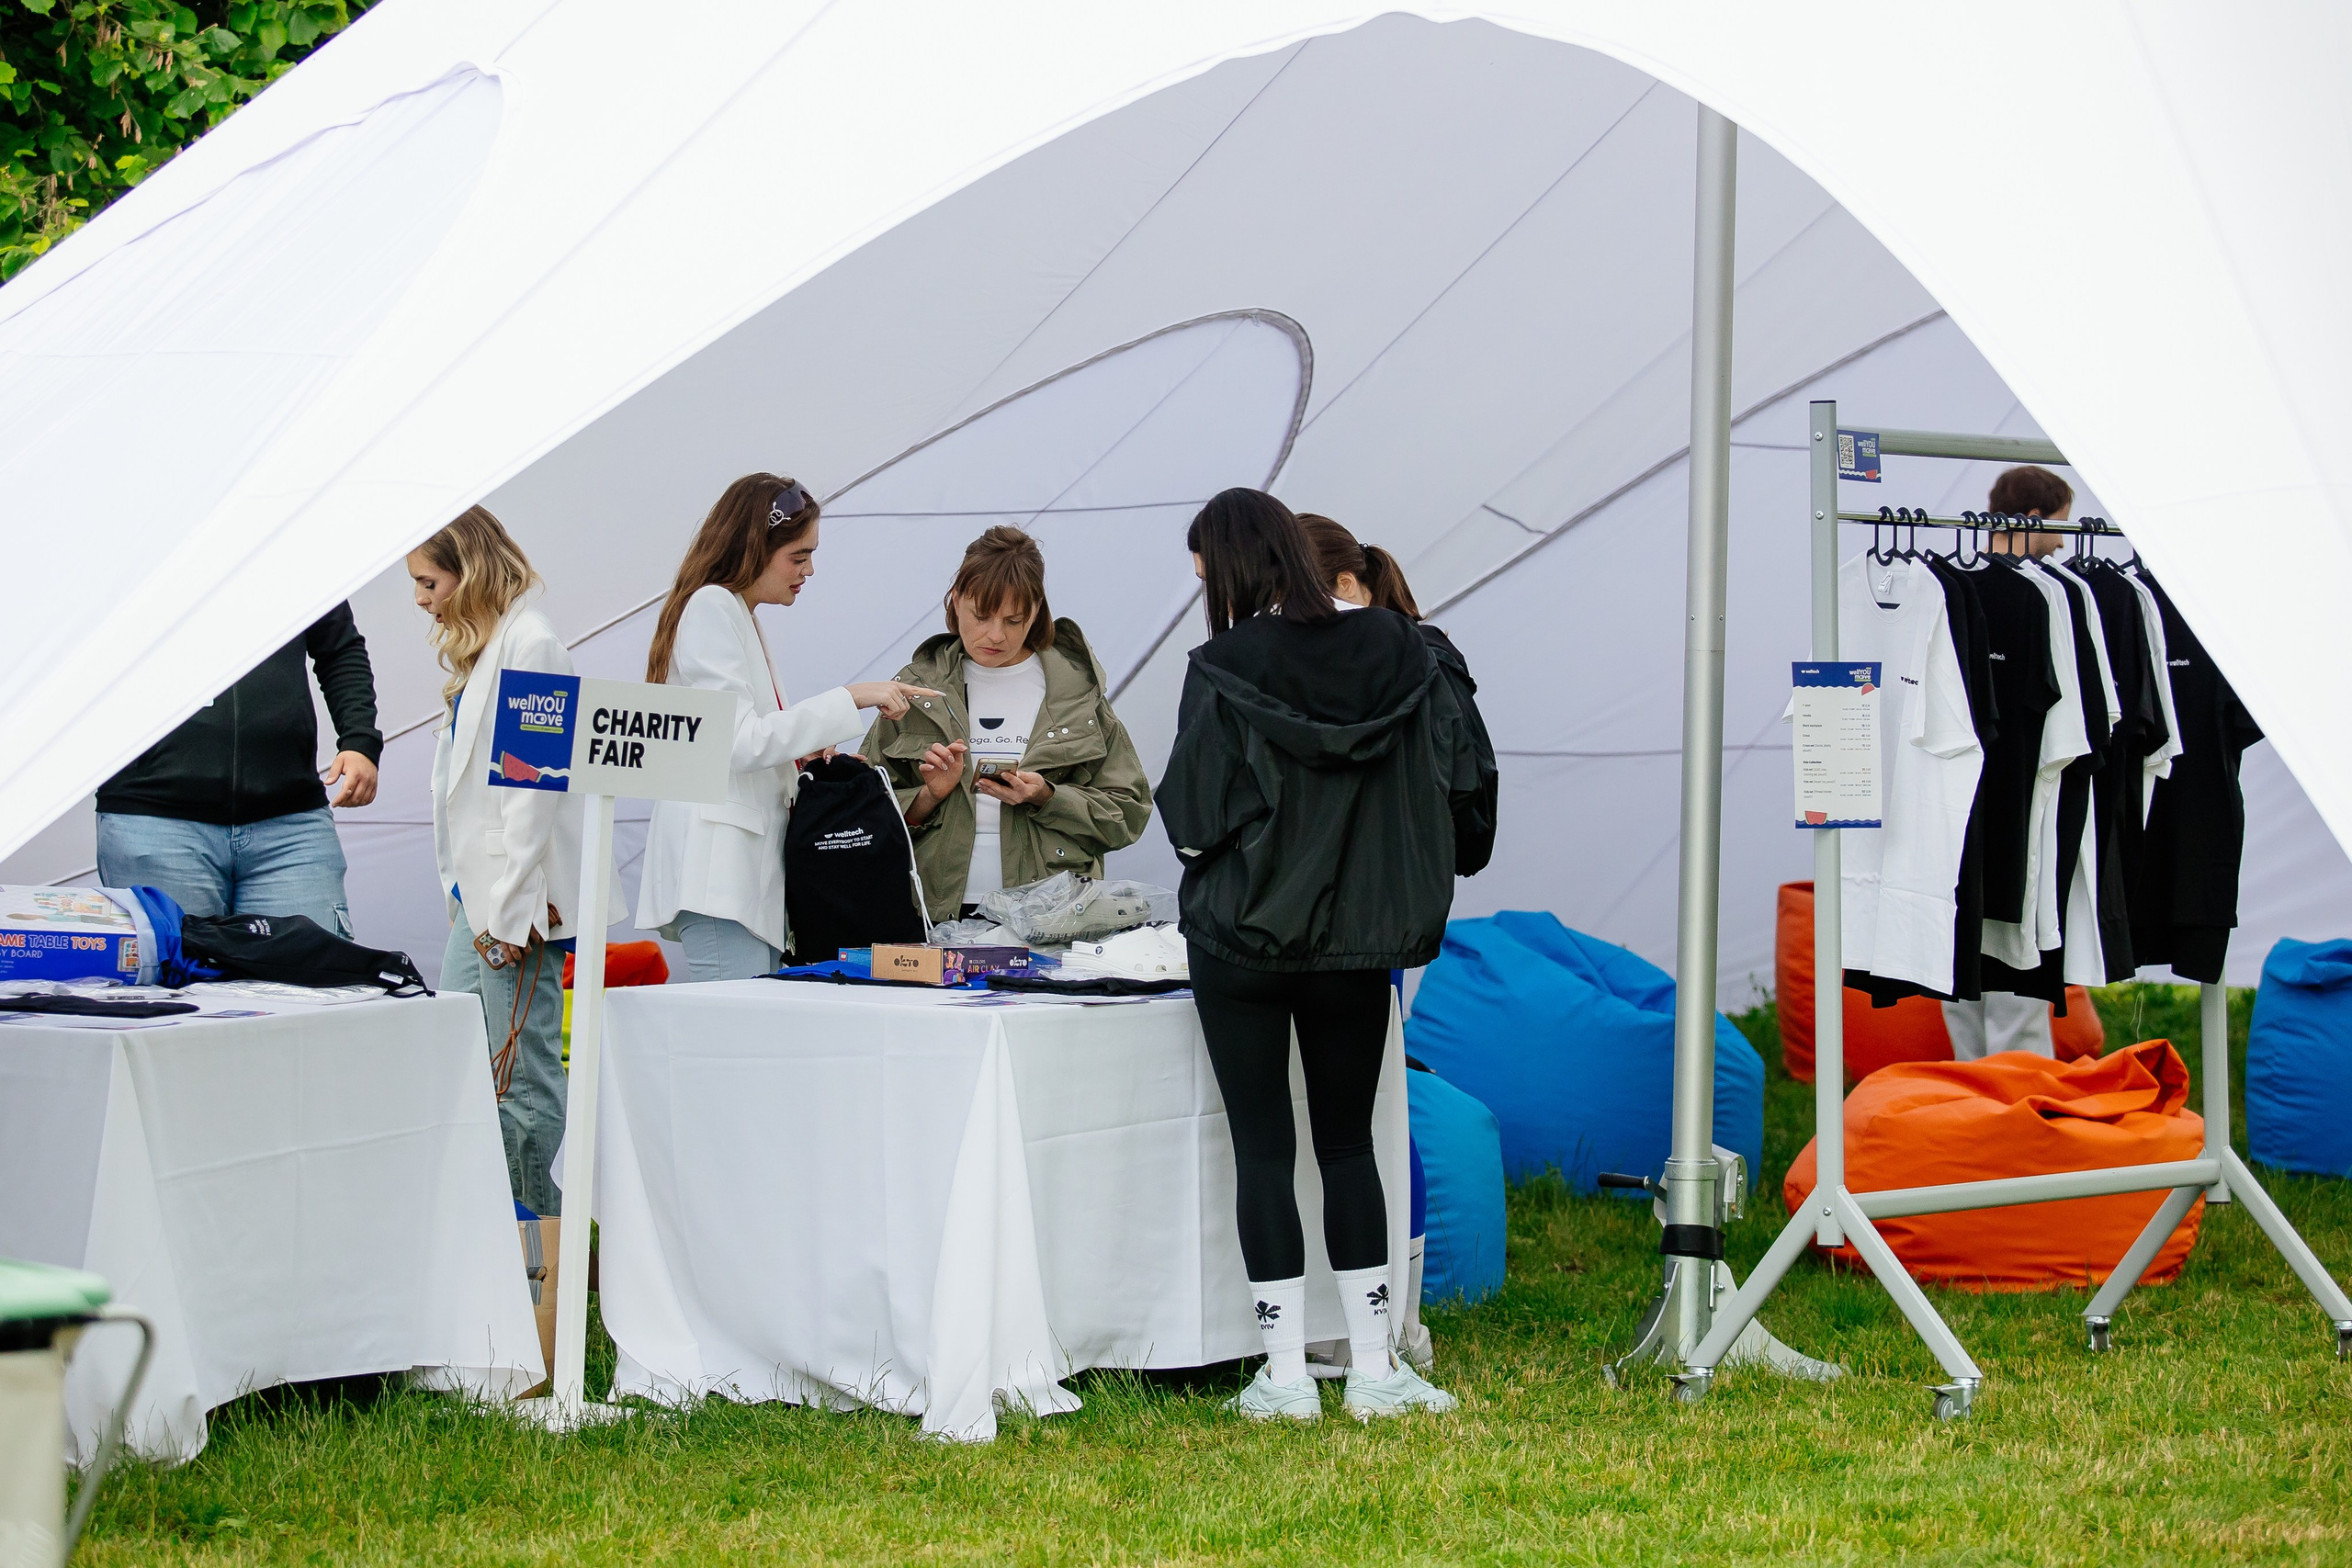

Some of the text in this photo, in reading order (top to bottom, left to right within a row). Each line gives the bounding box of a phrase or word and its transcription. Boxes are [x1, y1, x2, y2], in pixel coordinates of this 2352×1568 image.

[508, 694, 566, 714] wellYOU
[521, 711, 563, 727] move
[593, 707, 703, 743] CHARITY
[995, 736, 1013, 744] Go.
[588, 739, 645, 769] FAIR
[834, 827, 864, 838] welltech
[28, 935, 69, 950] TABLE
[71, 936, 107, 951] TOYS
[11, 949, 43, 958] BOARD
[967, 964, 980, 974] AIR
